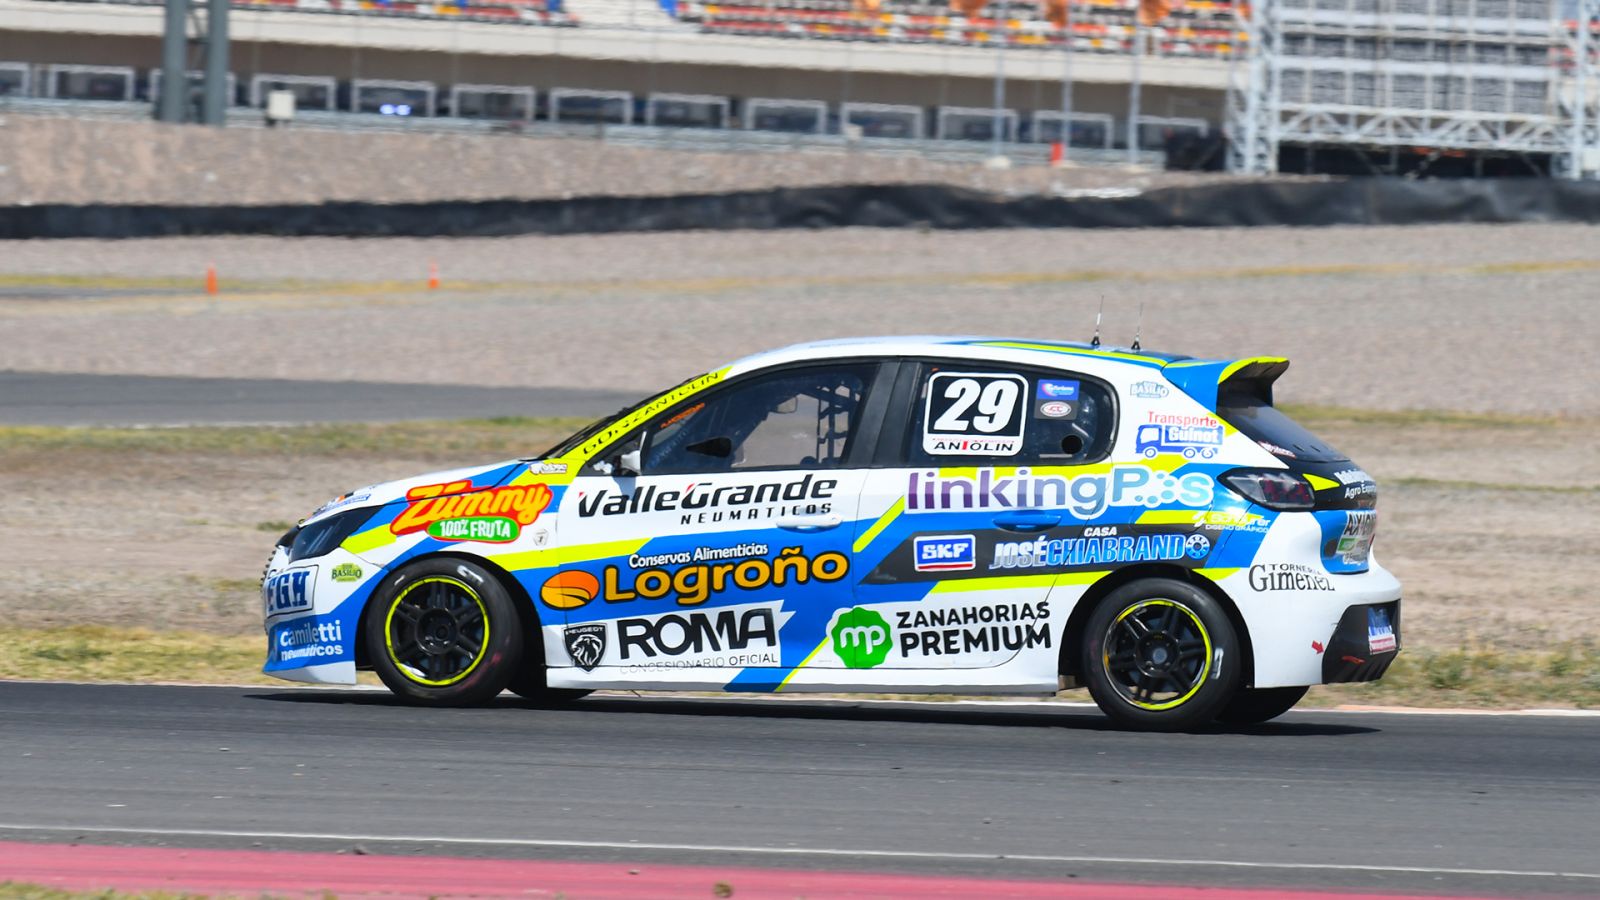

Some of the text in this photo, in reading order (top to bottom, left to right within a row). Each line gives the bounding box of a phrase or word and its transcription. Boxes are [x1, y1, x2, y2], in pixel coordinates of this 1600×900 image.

[933, 378, 1019, 433] 29
[1148, 410, 1217, 428] Transporte
[578, 473, 838, 518] ValleGrande
[680, 502, 832, 526] NEUMATICOS
[439, 520, 511, 538] 100% FRUTA
[1083, 527, 1118, 538] CASA
[628, 542, 769, 570] Conservas Alimenticias
[922, 542, 968, 559] SKF
[603, 547, 849, 605] Logroño
[897, 602, 1051, 629] ZANAHORIAS
[280, 619, 342, 647] camiletti
[617, 608, 776, 660] ROMA
[899, 624, 1052, 659] PREMIUM
[620, 652, 778, 674] CONCESIONARIO OFICIAL
